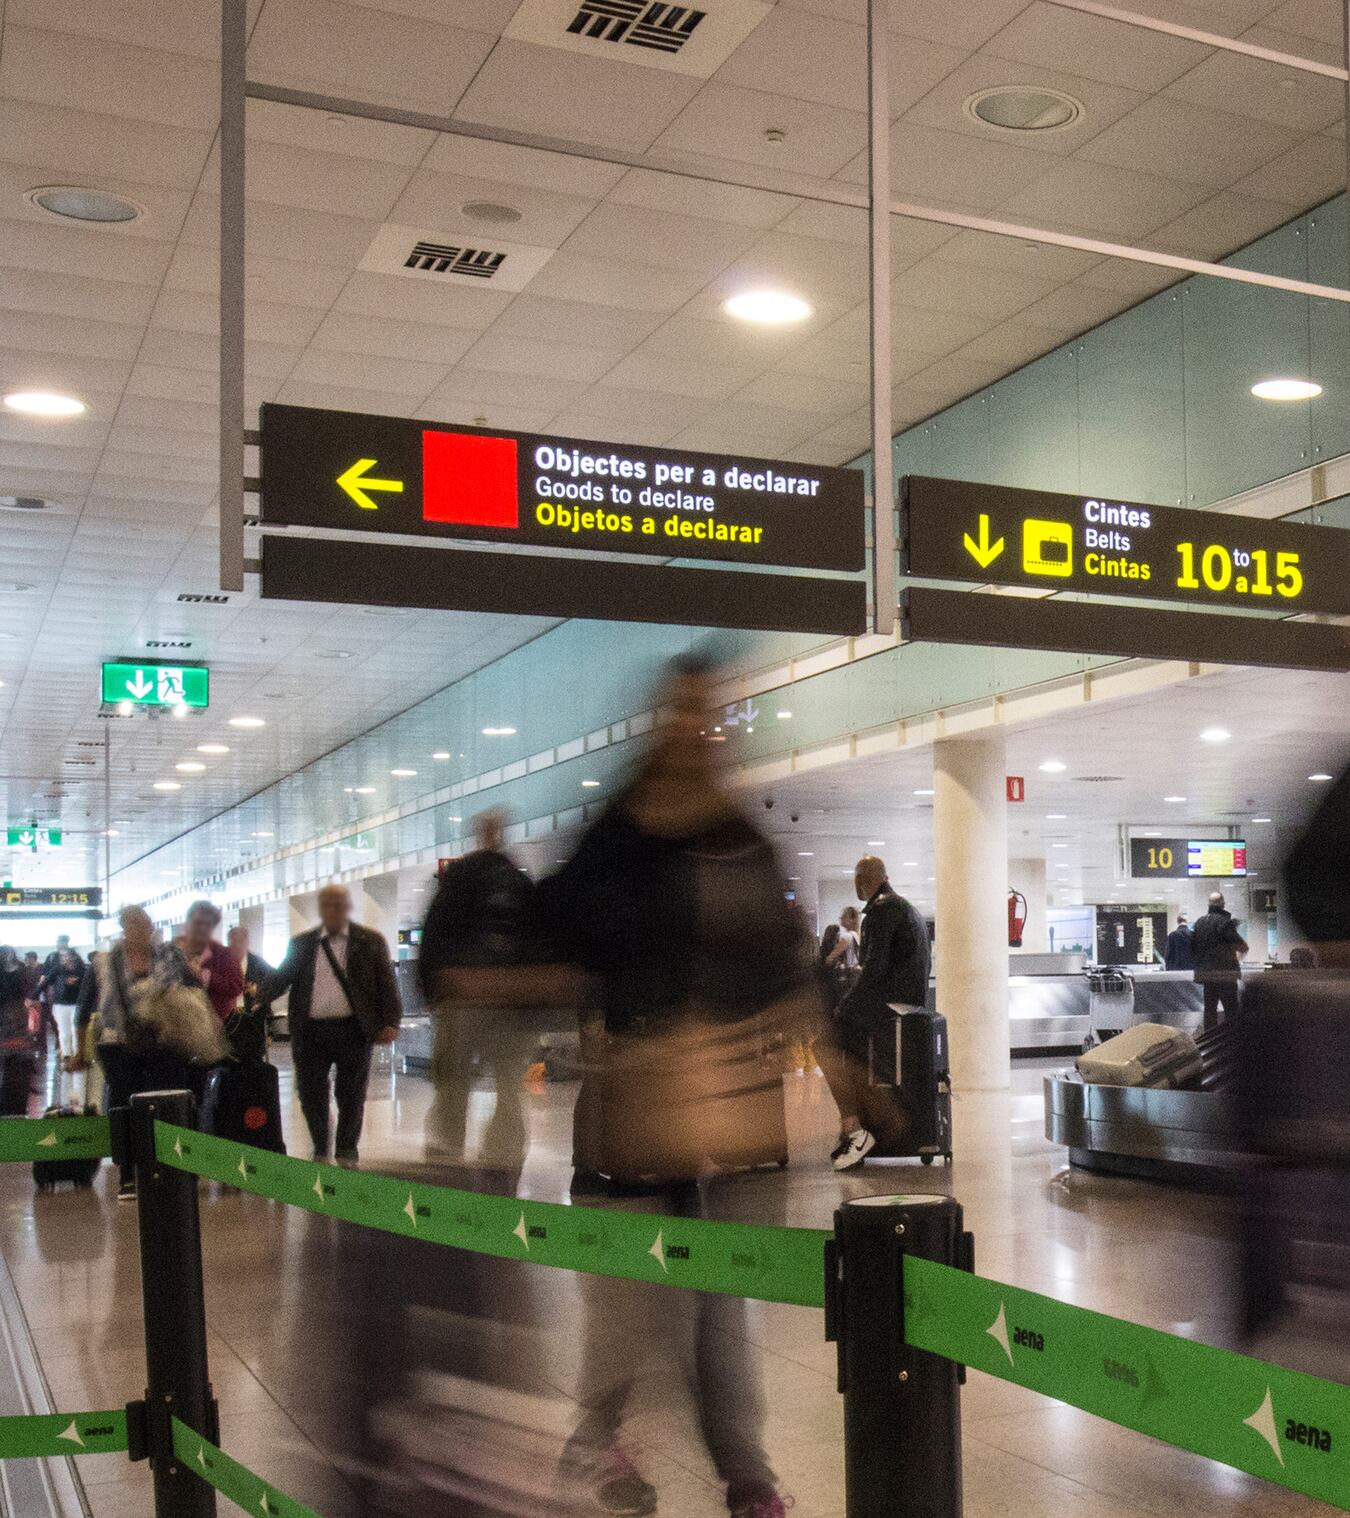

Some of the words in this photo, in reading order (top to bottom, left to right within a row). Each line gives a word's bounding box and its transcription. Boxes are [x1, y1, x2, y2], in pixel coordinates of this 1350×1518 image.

[534, 446, 647, 480] Objectes
[655, 463, 695, 486] per
[702, 468, 717, 487] a
[723, 466, 820, 497] declarar
[535, 476, 607, 501] Goods
[610, 484, 633, 505] to
[639, 487, 715, 513] declare
[534, 502, 634, 534] Objetos
[641, 517, 656, 535] a
[663, 515, 764, 544] declarar
[1084, 501, 1151, 529] Cintes
[1085, 528, 1131, 552] Belts
[1084, 553, 1152, 581] Cintas
[1175, 541, 1233, 592] 10
[1233, 548, 1250, 567] to
[1235, 576, 1249, 593] a
[1250, 549, 1305, 598] 15
[1148, 848, 1173, 869] 10
[1014, 1326, 1045, 1352] aena
[84, 1427, 114, 1436] aena
[1285, 1418, 1332, 1453] aena
